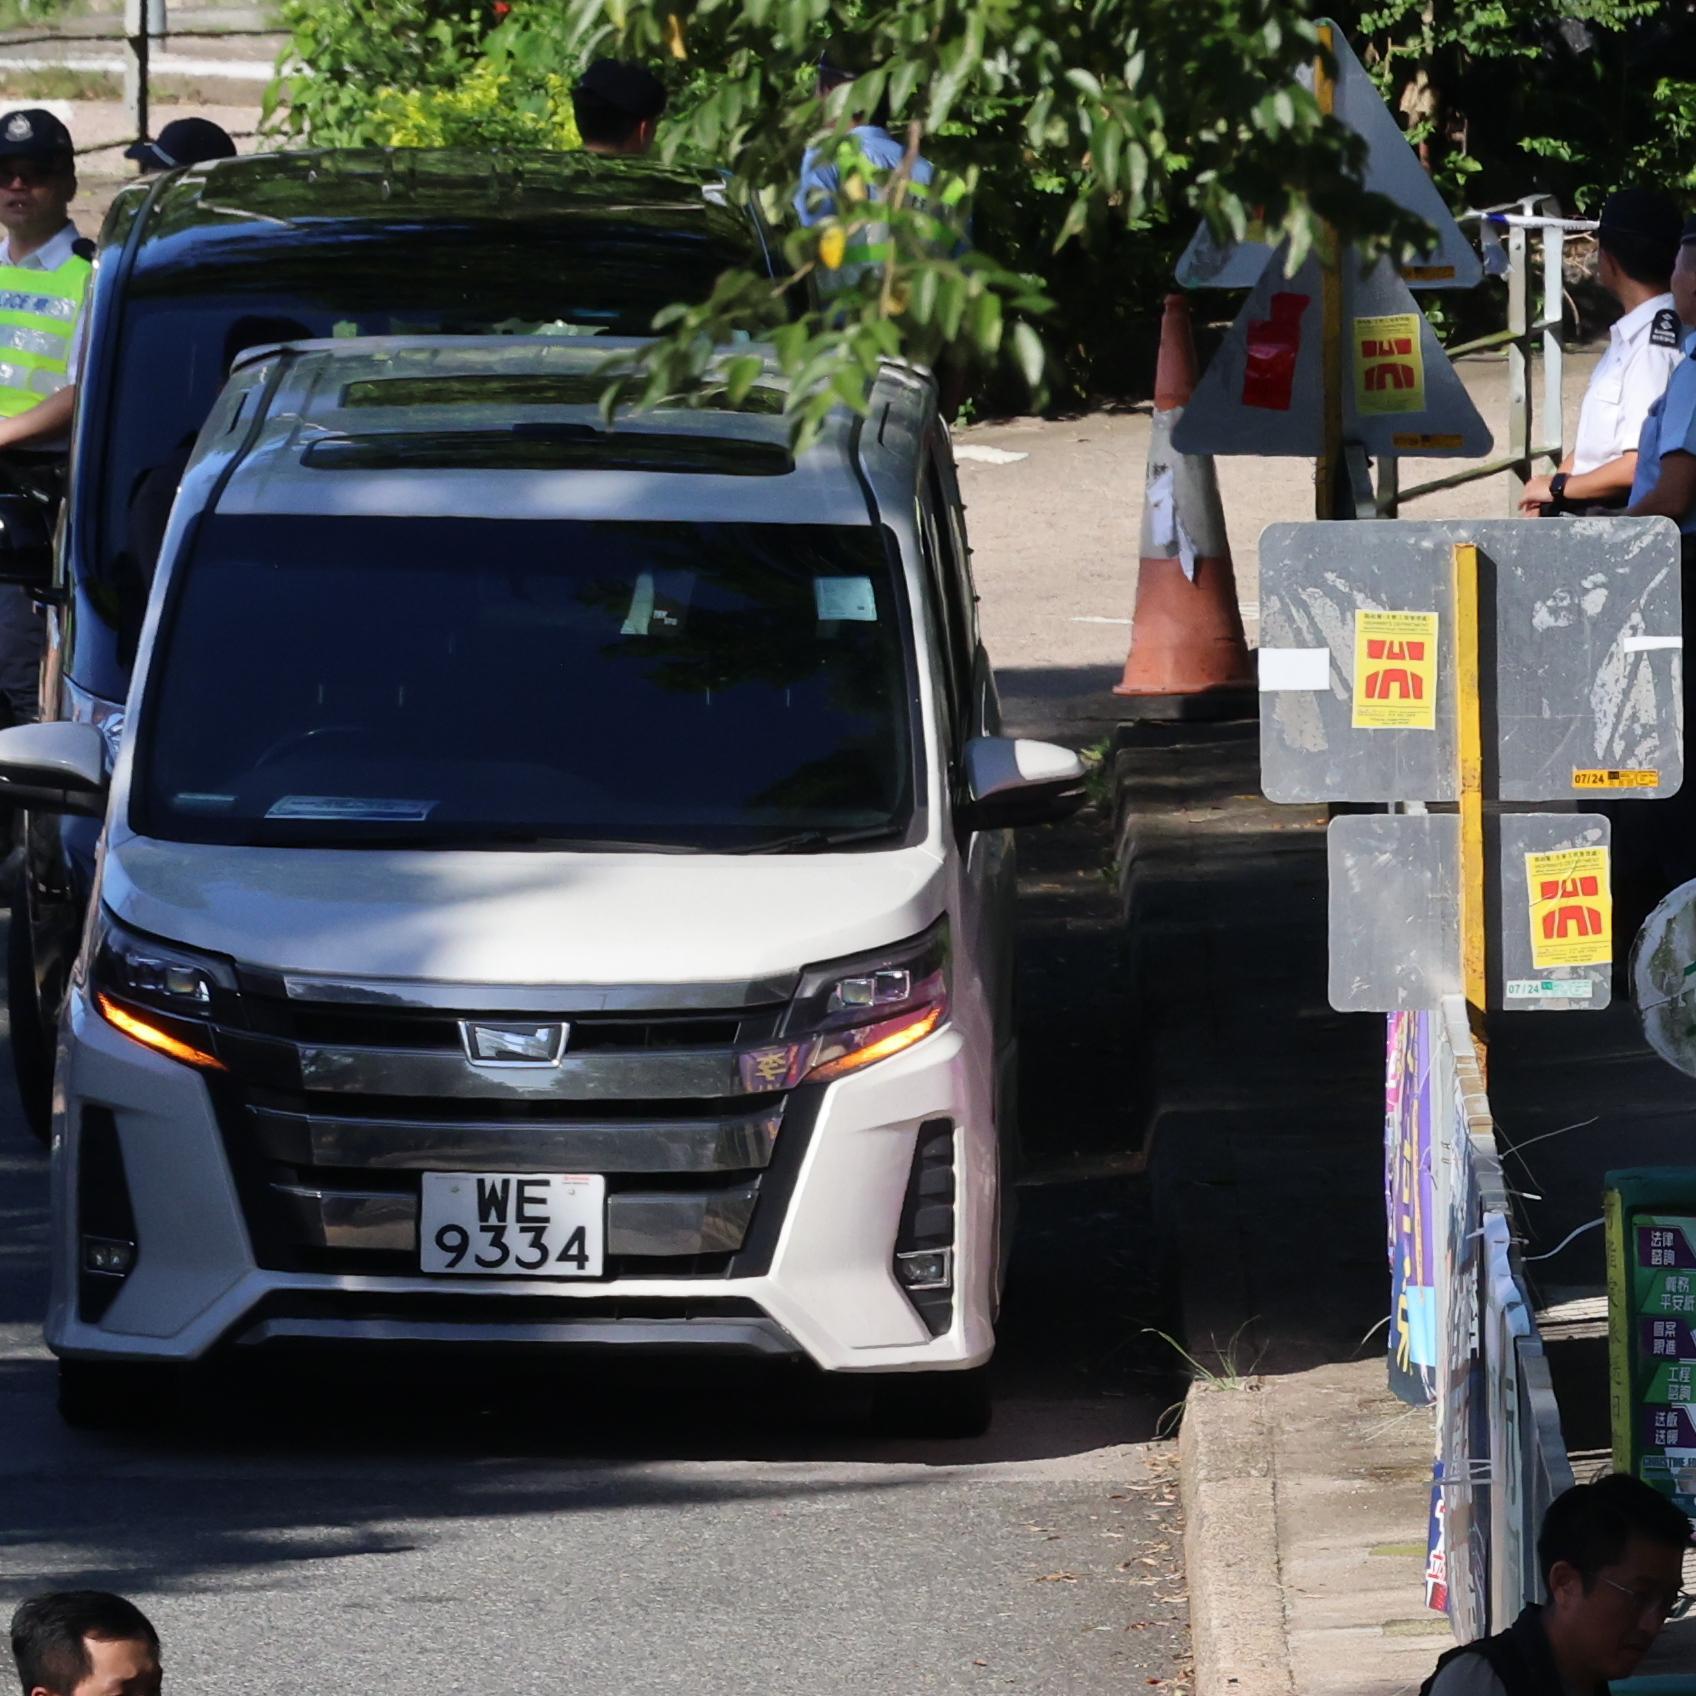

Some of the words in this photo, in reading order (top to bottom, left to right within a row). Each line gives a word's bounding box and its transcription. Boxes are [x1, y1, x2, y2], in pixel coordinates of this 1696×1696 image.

[1574, 773, 1605, 785] 07/24
[477, 1178, 551, 1223] WE
[435, 1224, 589, 1270] 9334
[1667, 1367, 1690, 1382] 工程
